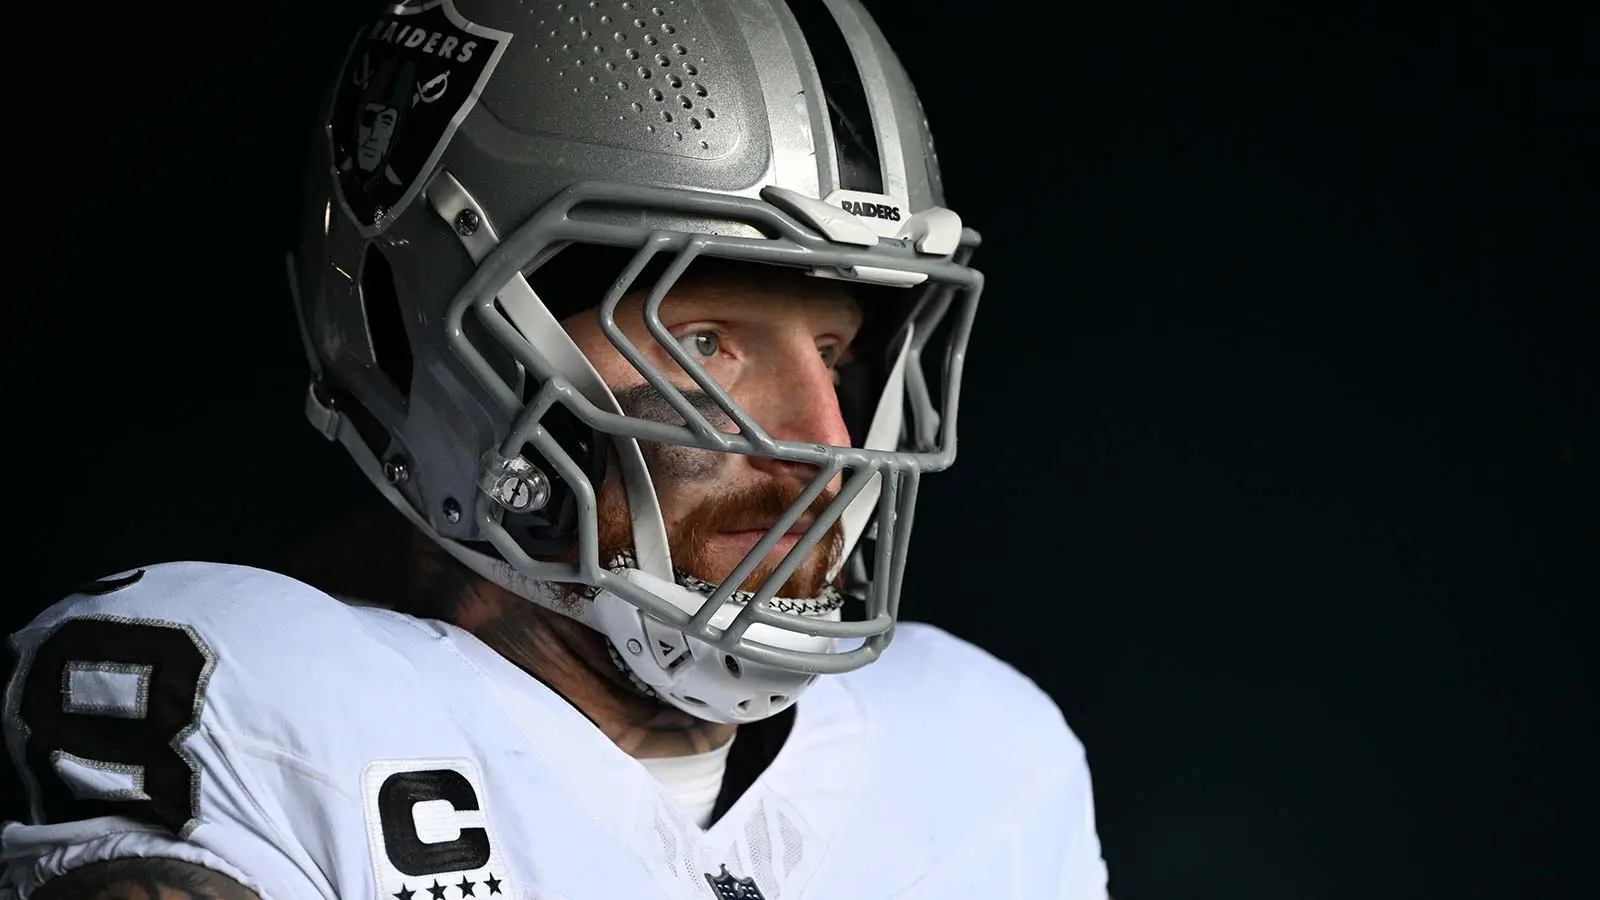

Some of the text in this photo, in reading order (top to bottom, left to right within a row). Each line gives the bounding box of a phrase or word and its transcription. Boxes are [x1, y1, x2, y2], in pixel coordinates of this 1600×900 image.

[368, 19, 478, 63] RAIDERS
[841, 201, 901, 222] RAIDERS
[378, 769, 491, 877] C
